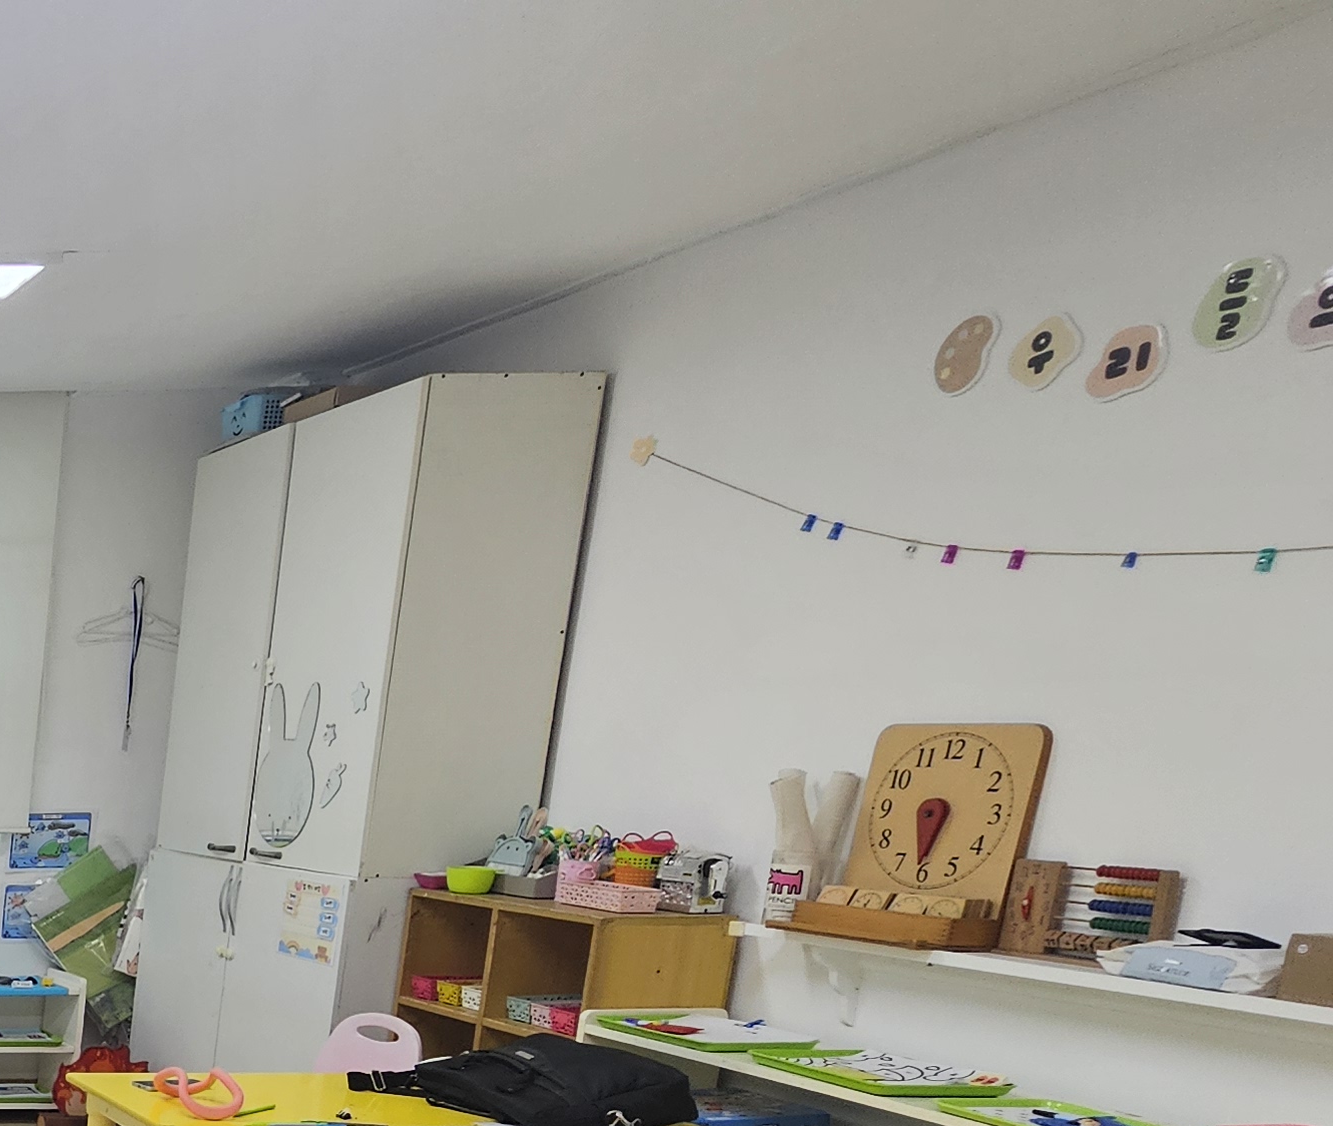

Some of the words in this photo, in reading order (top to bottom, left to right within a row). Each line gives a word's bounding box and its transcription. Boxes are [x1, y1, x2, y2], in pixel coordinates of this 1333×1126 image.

[915, 747, 935, 768] 11
[943, 738, 966, 760] 12
[973, 746, 985, 769] 1
[889, 768, 912, 790] 10
[986, 770, 1002, 793] 2
[879, 798, 893, 819] 9
[986, 803, 1002, 825] 3
[878, 828, 892, 849] 8
[969, 834, 985, 856] 4
[894, 852, 907, 872] 7
[916, 861, 931, 883] 6
[943, 856, 960, 878] 5
